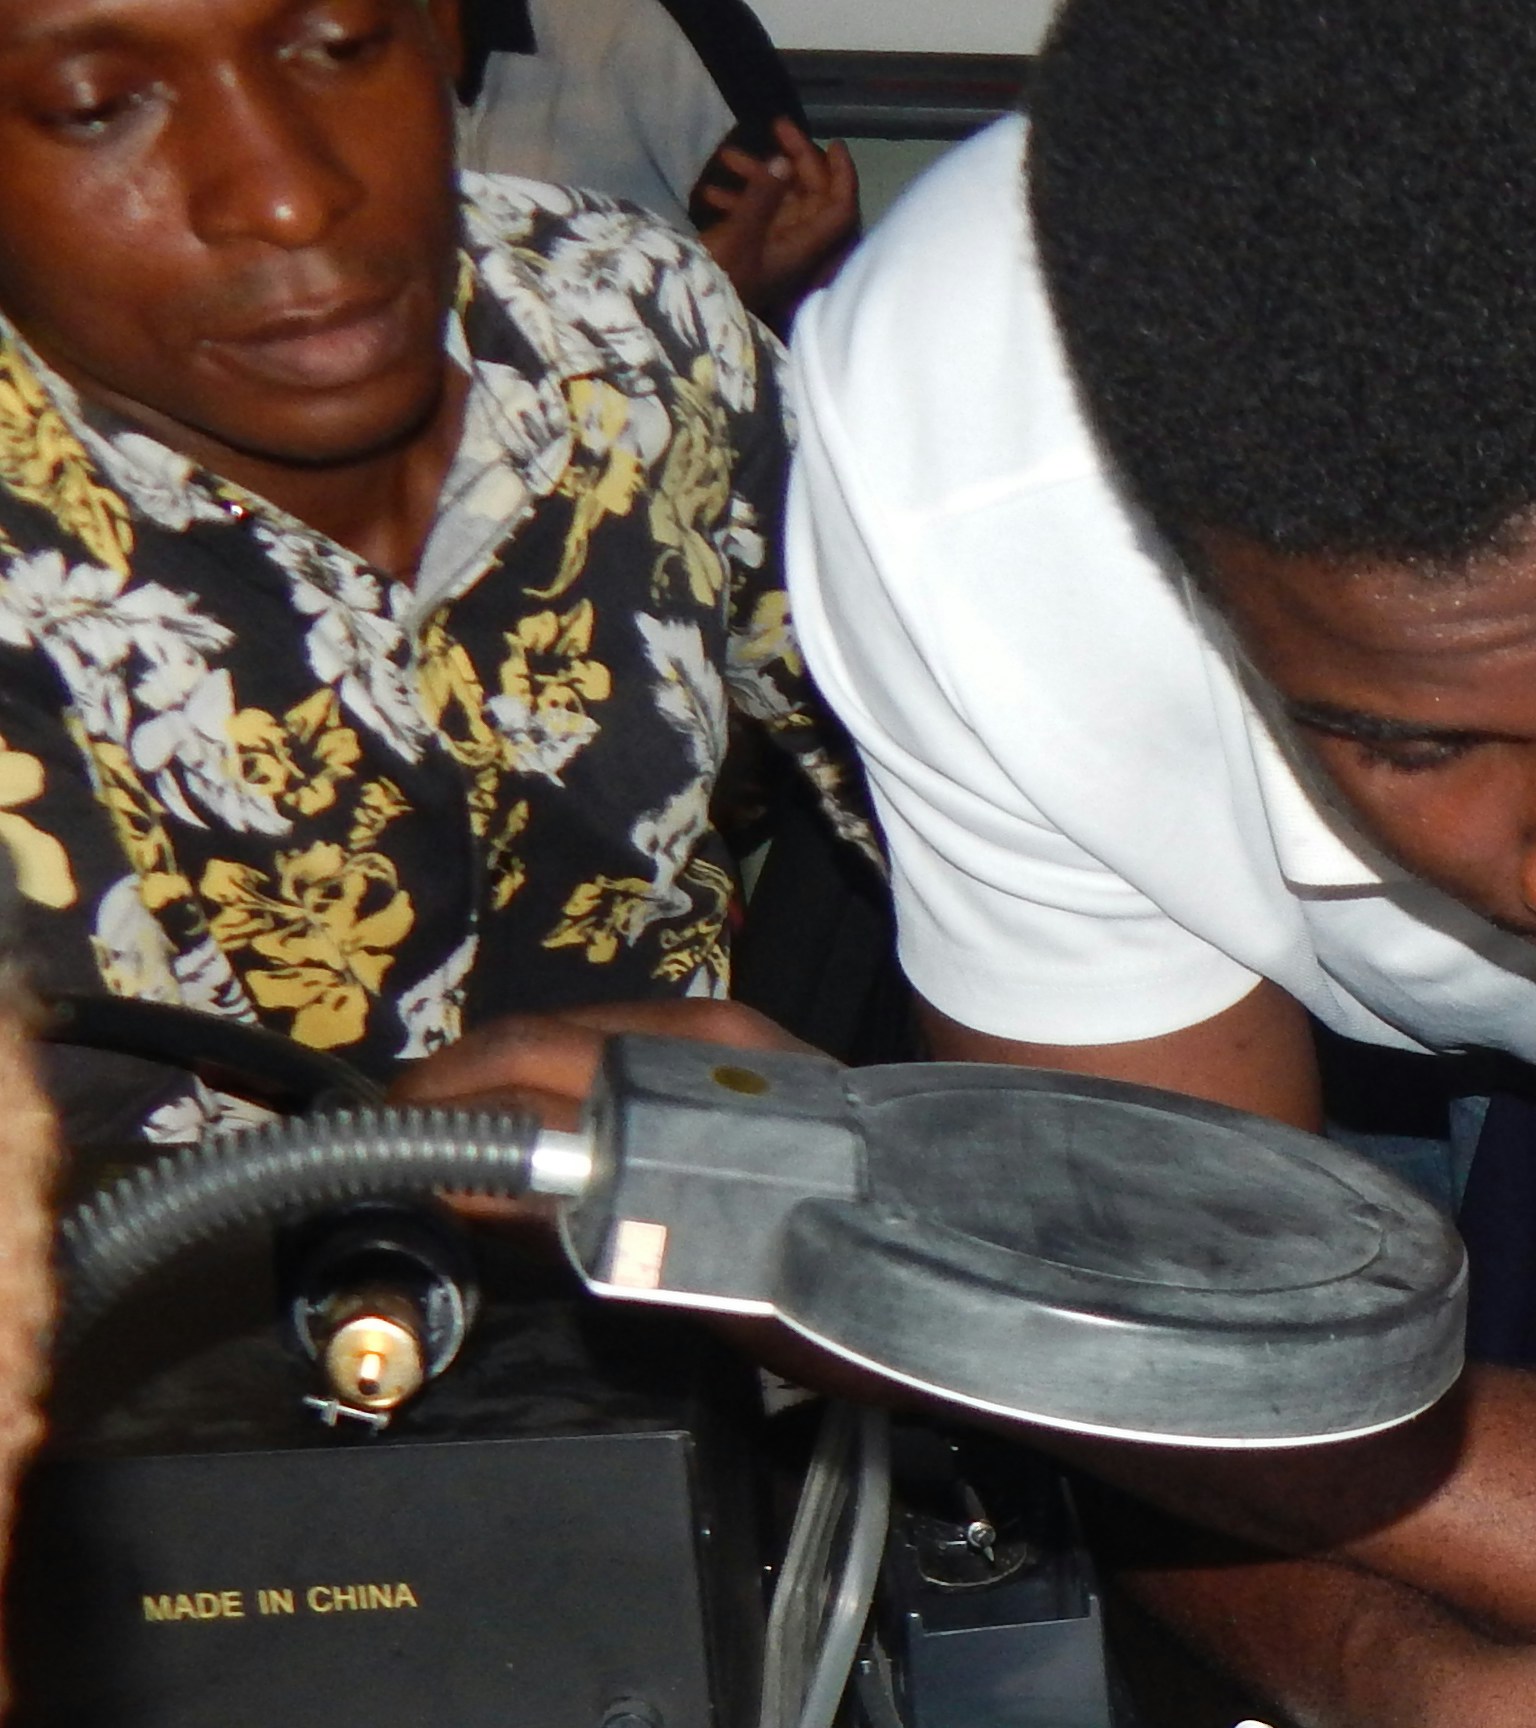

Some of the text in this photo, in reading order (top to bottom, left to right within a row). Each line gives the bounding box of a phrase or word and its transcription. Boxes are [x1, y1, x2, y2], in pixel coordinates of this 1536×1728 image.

[142, 1582, 418, 1622] MADE IN CHINA
